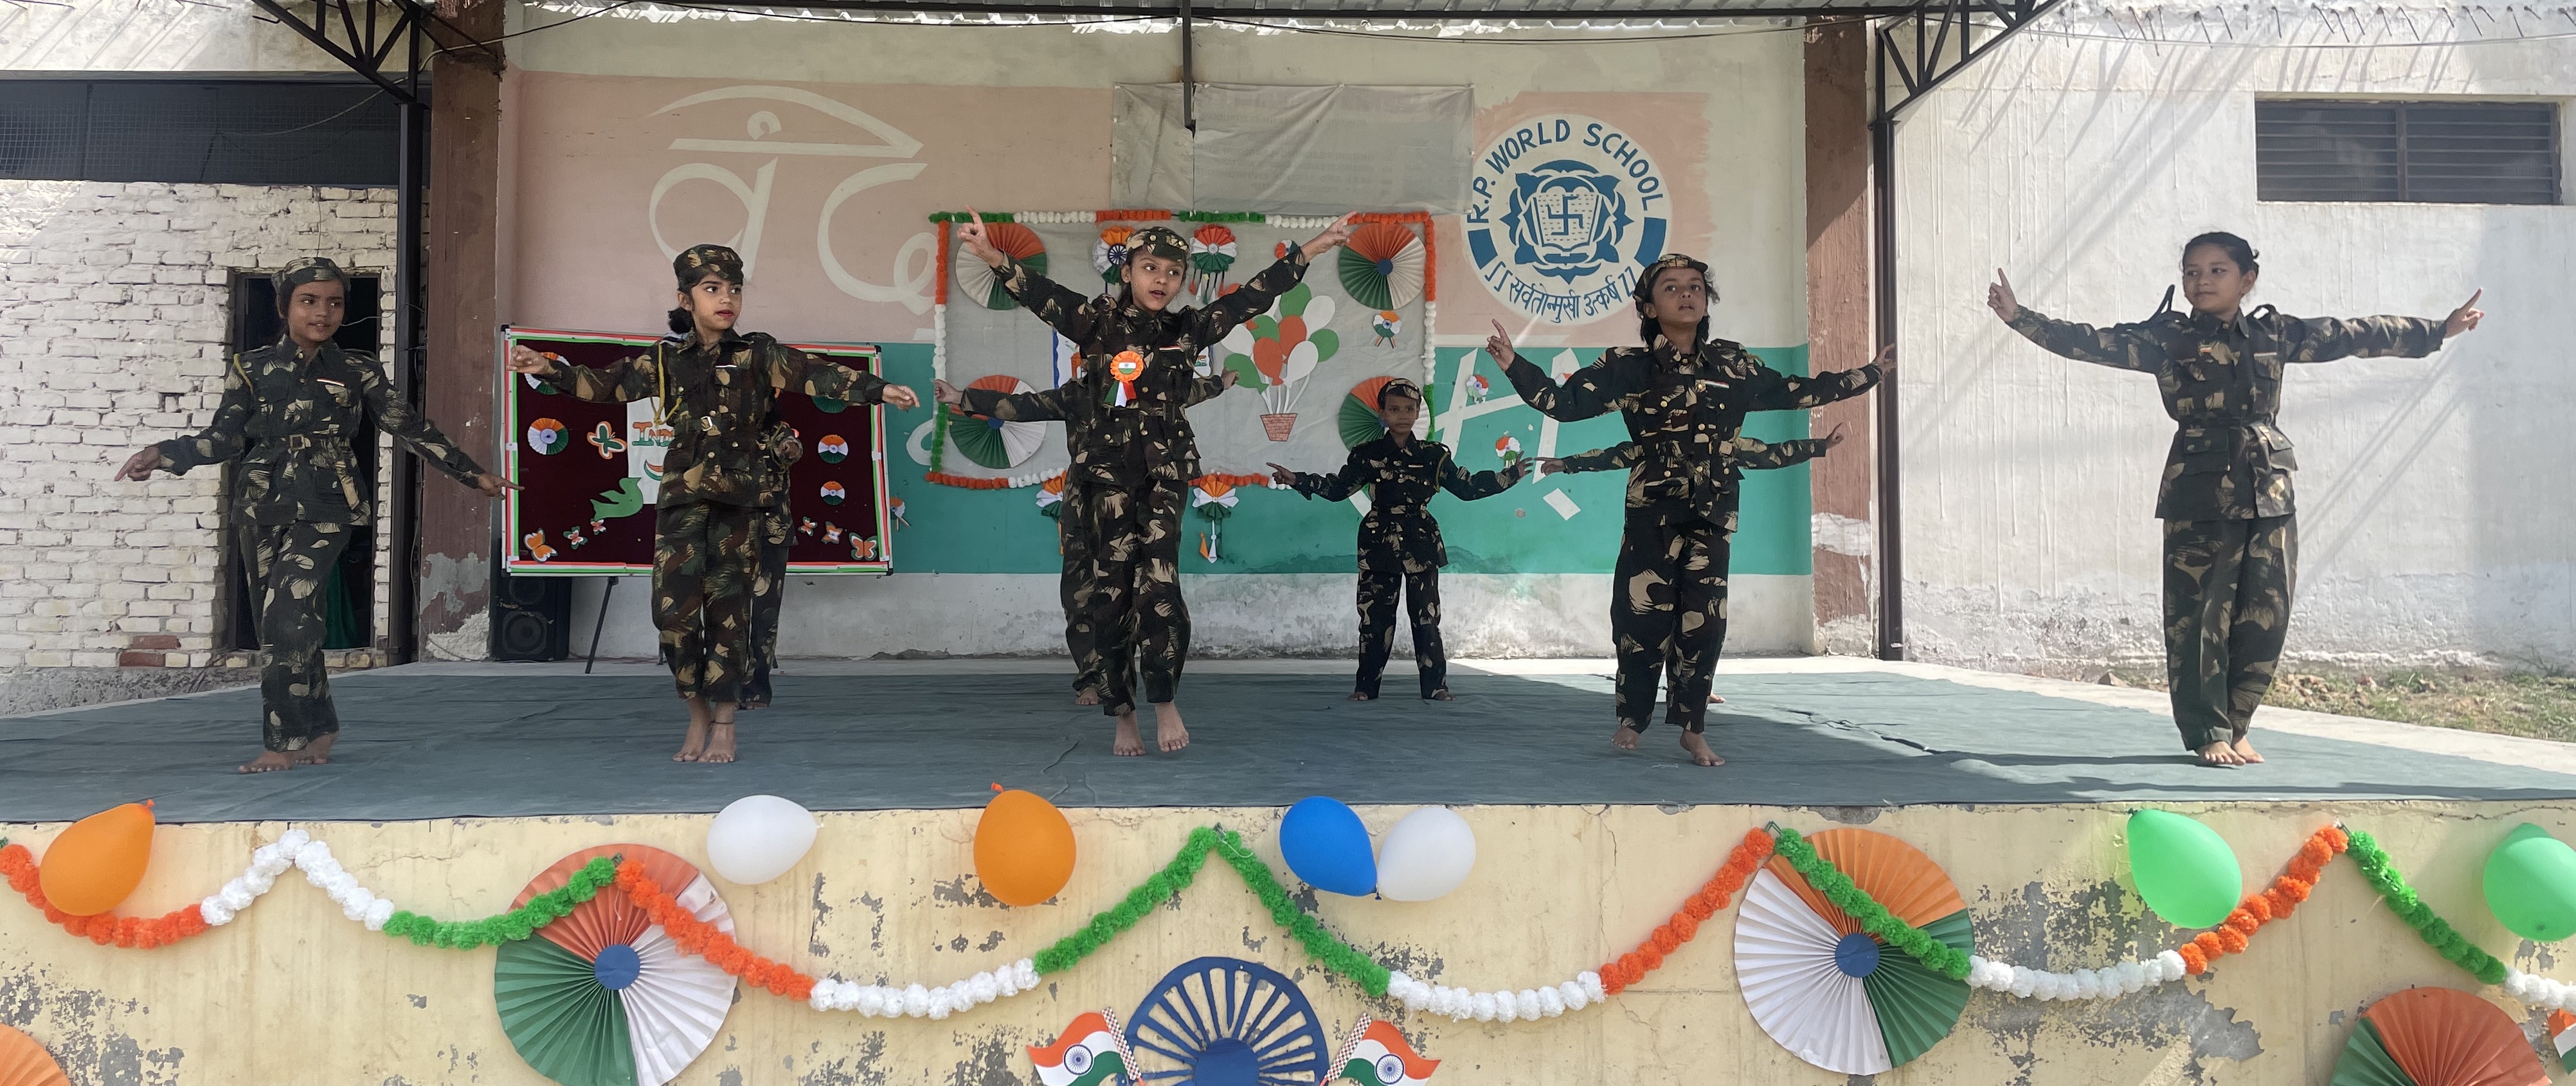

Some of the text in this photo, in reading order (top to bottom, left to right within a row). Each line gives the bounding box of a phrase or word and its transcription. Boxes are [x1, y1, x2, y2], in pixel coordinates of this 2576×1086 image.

[1466, 119, 1664, 223] R.P. WORLD SCHOOL
[632, 421, 675, 447] IND
